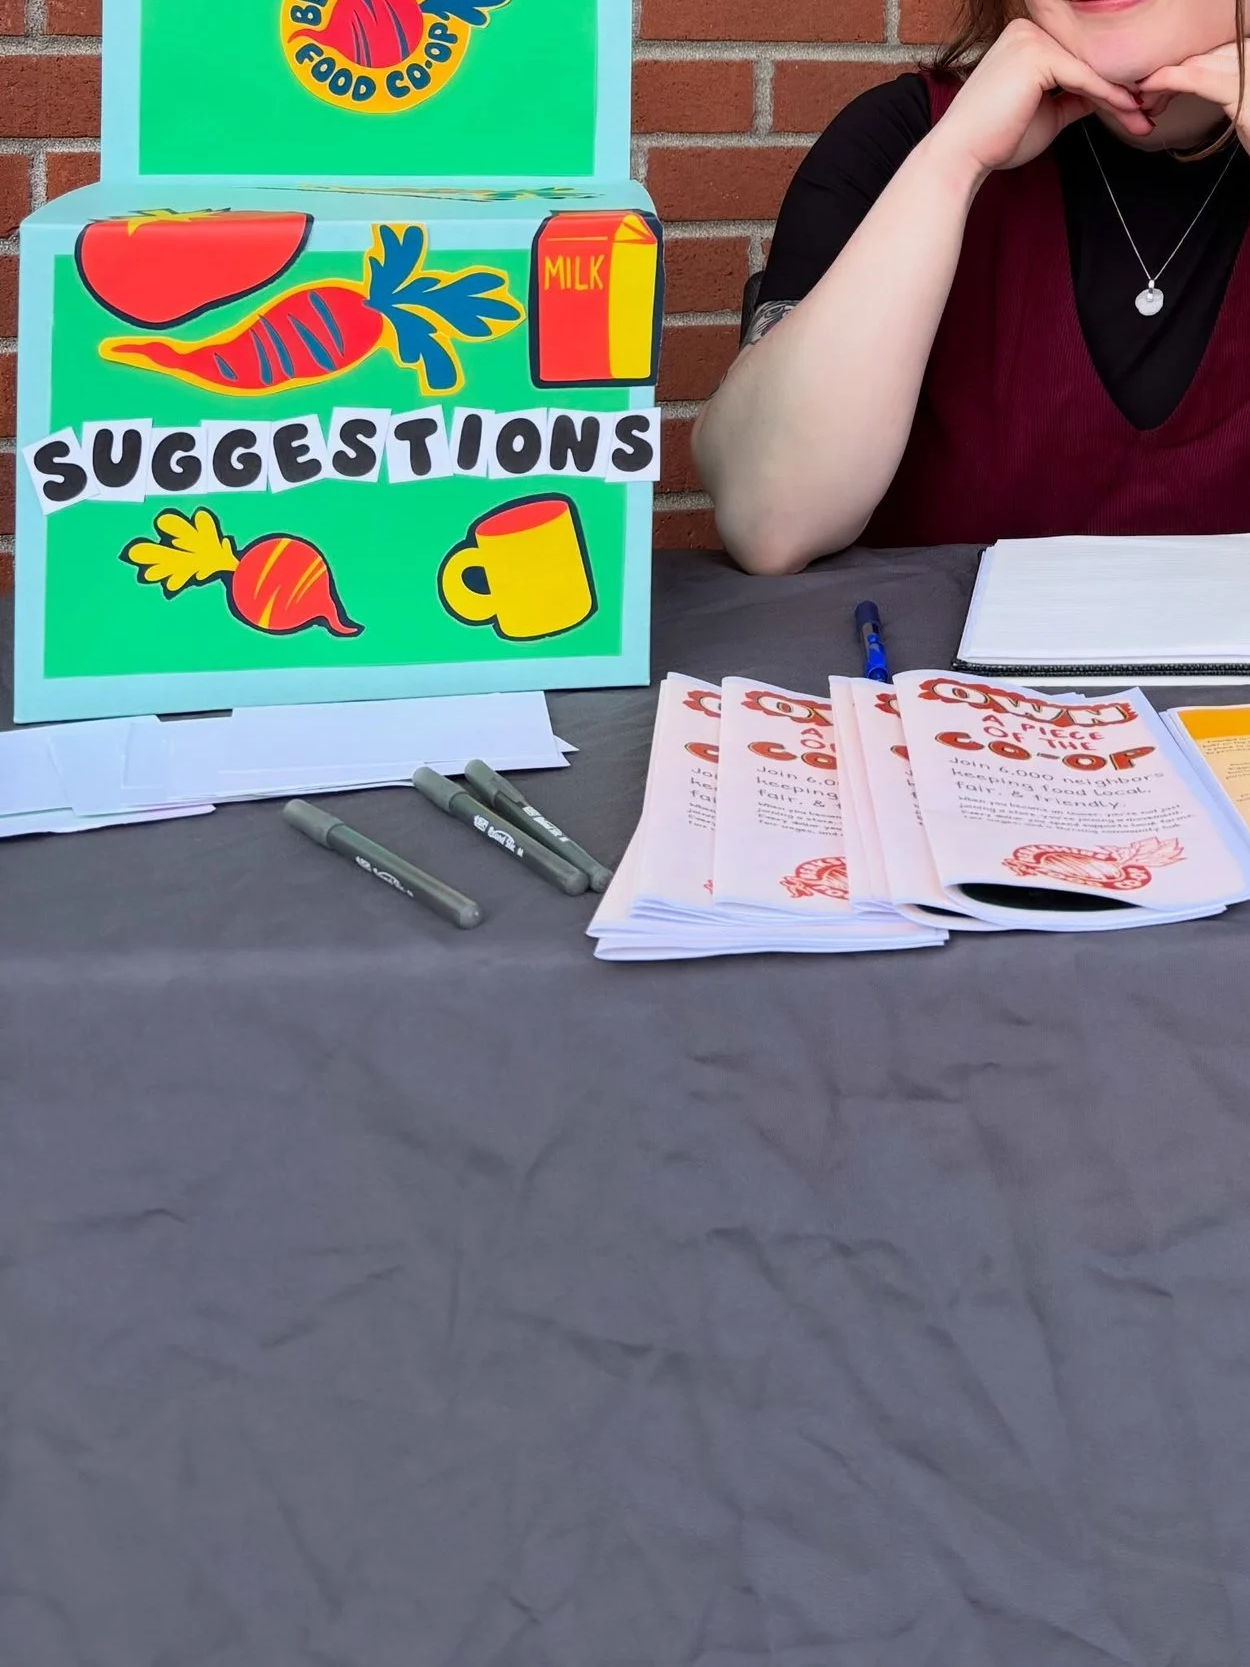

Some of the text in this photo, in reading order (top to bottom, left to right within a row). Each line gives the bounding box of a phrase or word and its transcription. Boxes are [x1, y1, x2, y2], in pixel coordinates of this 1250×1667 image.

[295, 22, 458, 102] FOOD CO-OP
[545, 253, 605, 292] MILK
[34, 414, 656, 502] SUGGESTIONS
[933, 683, 1128, 726] OWN
[982, 714, 1104, 740] A PIECE
[984, 726, 1099, 751] OF THE
[934, 731, 1156, 771] CO-OP
[692, 767, 718, 780] Joi
[756, 766, 798, 780] Join
[949, 757, 991, 772] Join
[1063, 772, 1165, 789] neighbors
[951, 768, 1013, 793] keeping
[1042, 782, 1090, 796] food
[756, 776, 839, 800] keeping
[1010, 790, 1025, 799] &
[813, 800, 826, 808] &
